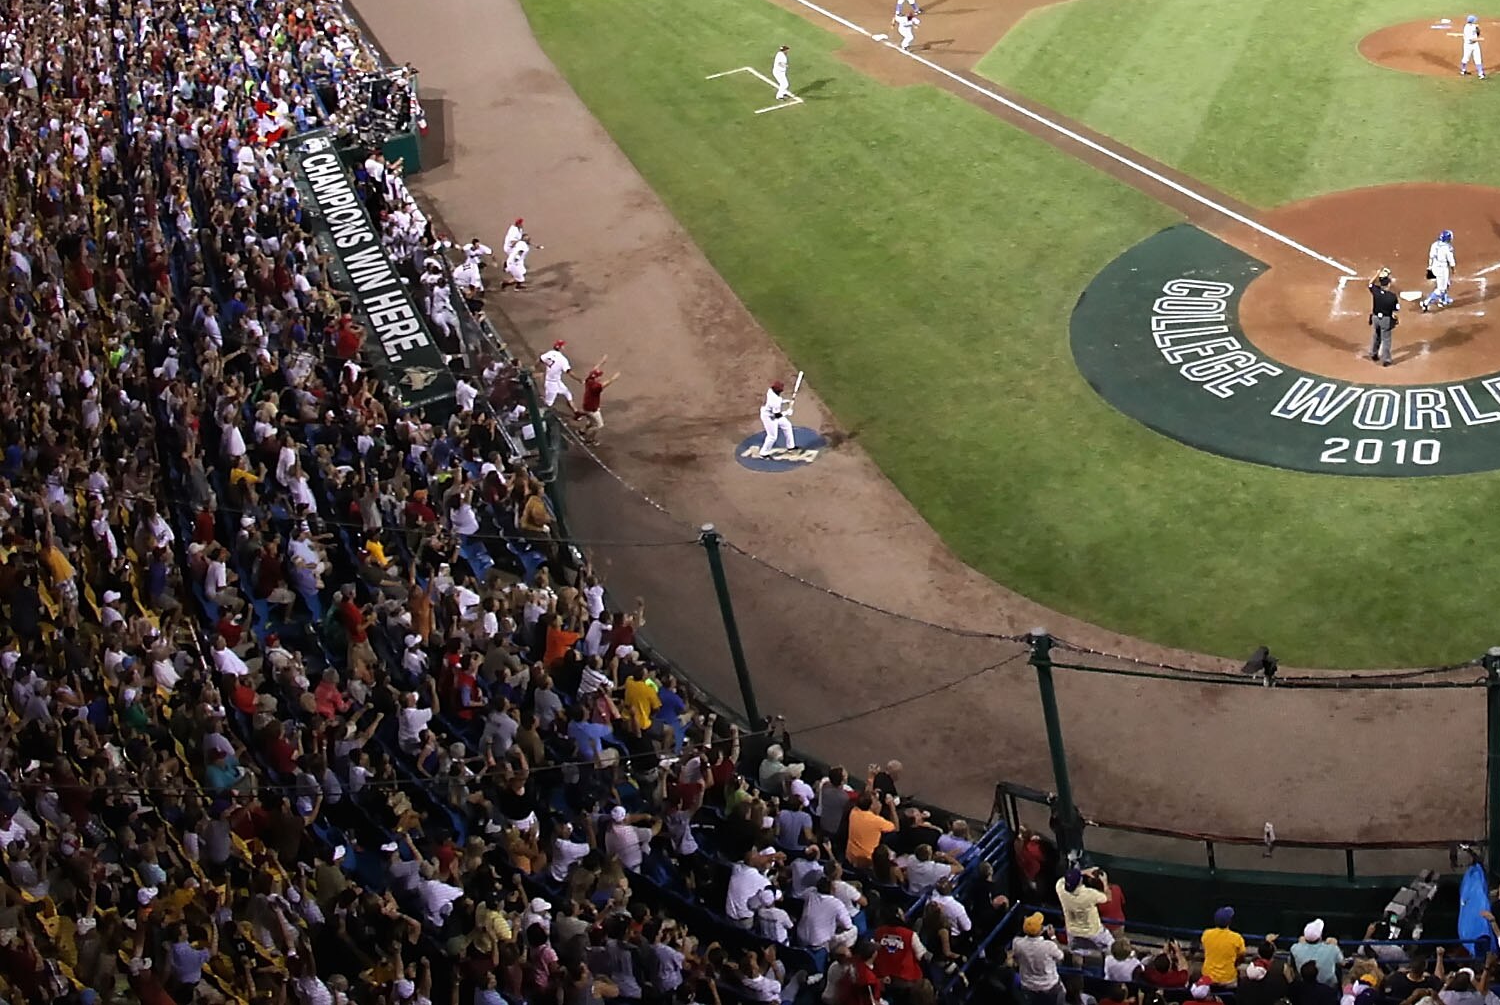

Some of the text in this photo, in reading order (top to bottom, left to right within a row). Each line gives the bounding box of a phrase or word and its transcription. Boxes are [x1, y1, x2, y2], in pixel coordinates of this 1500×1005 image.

[302, 153, 374, 247] CHAMPIONS
[343, 245, 396, 293] WIN
[363, 290, 429, 363] HERE.
[1151, 278, 1284, 398] COLLEGE
[1319, 437, 1441, 466] 2010
